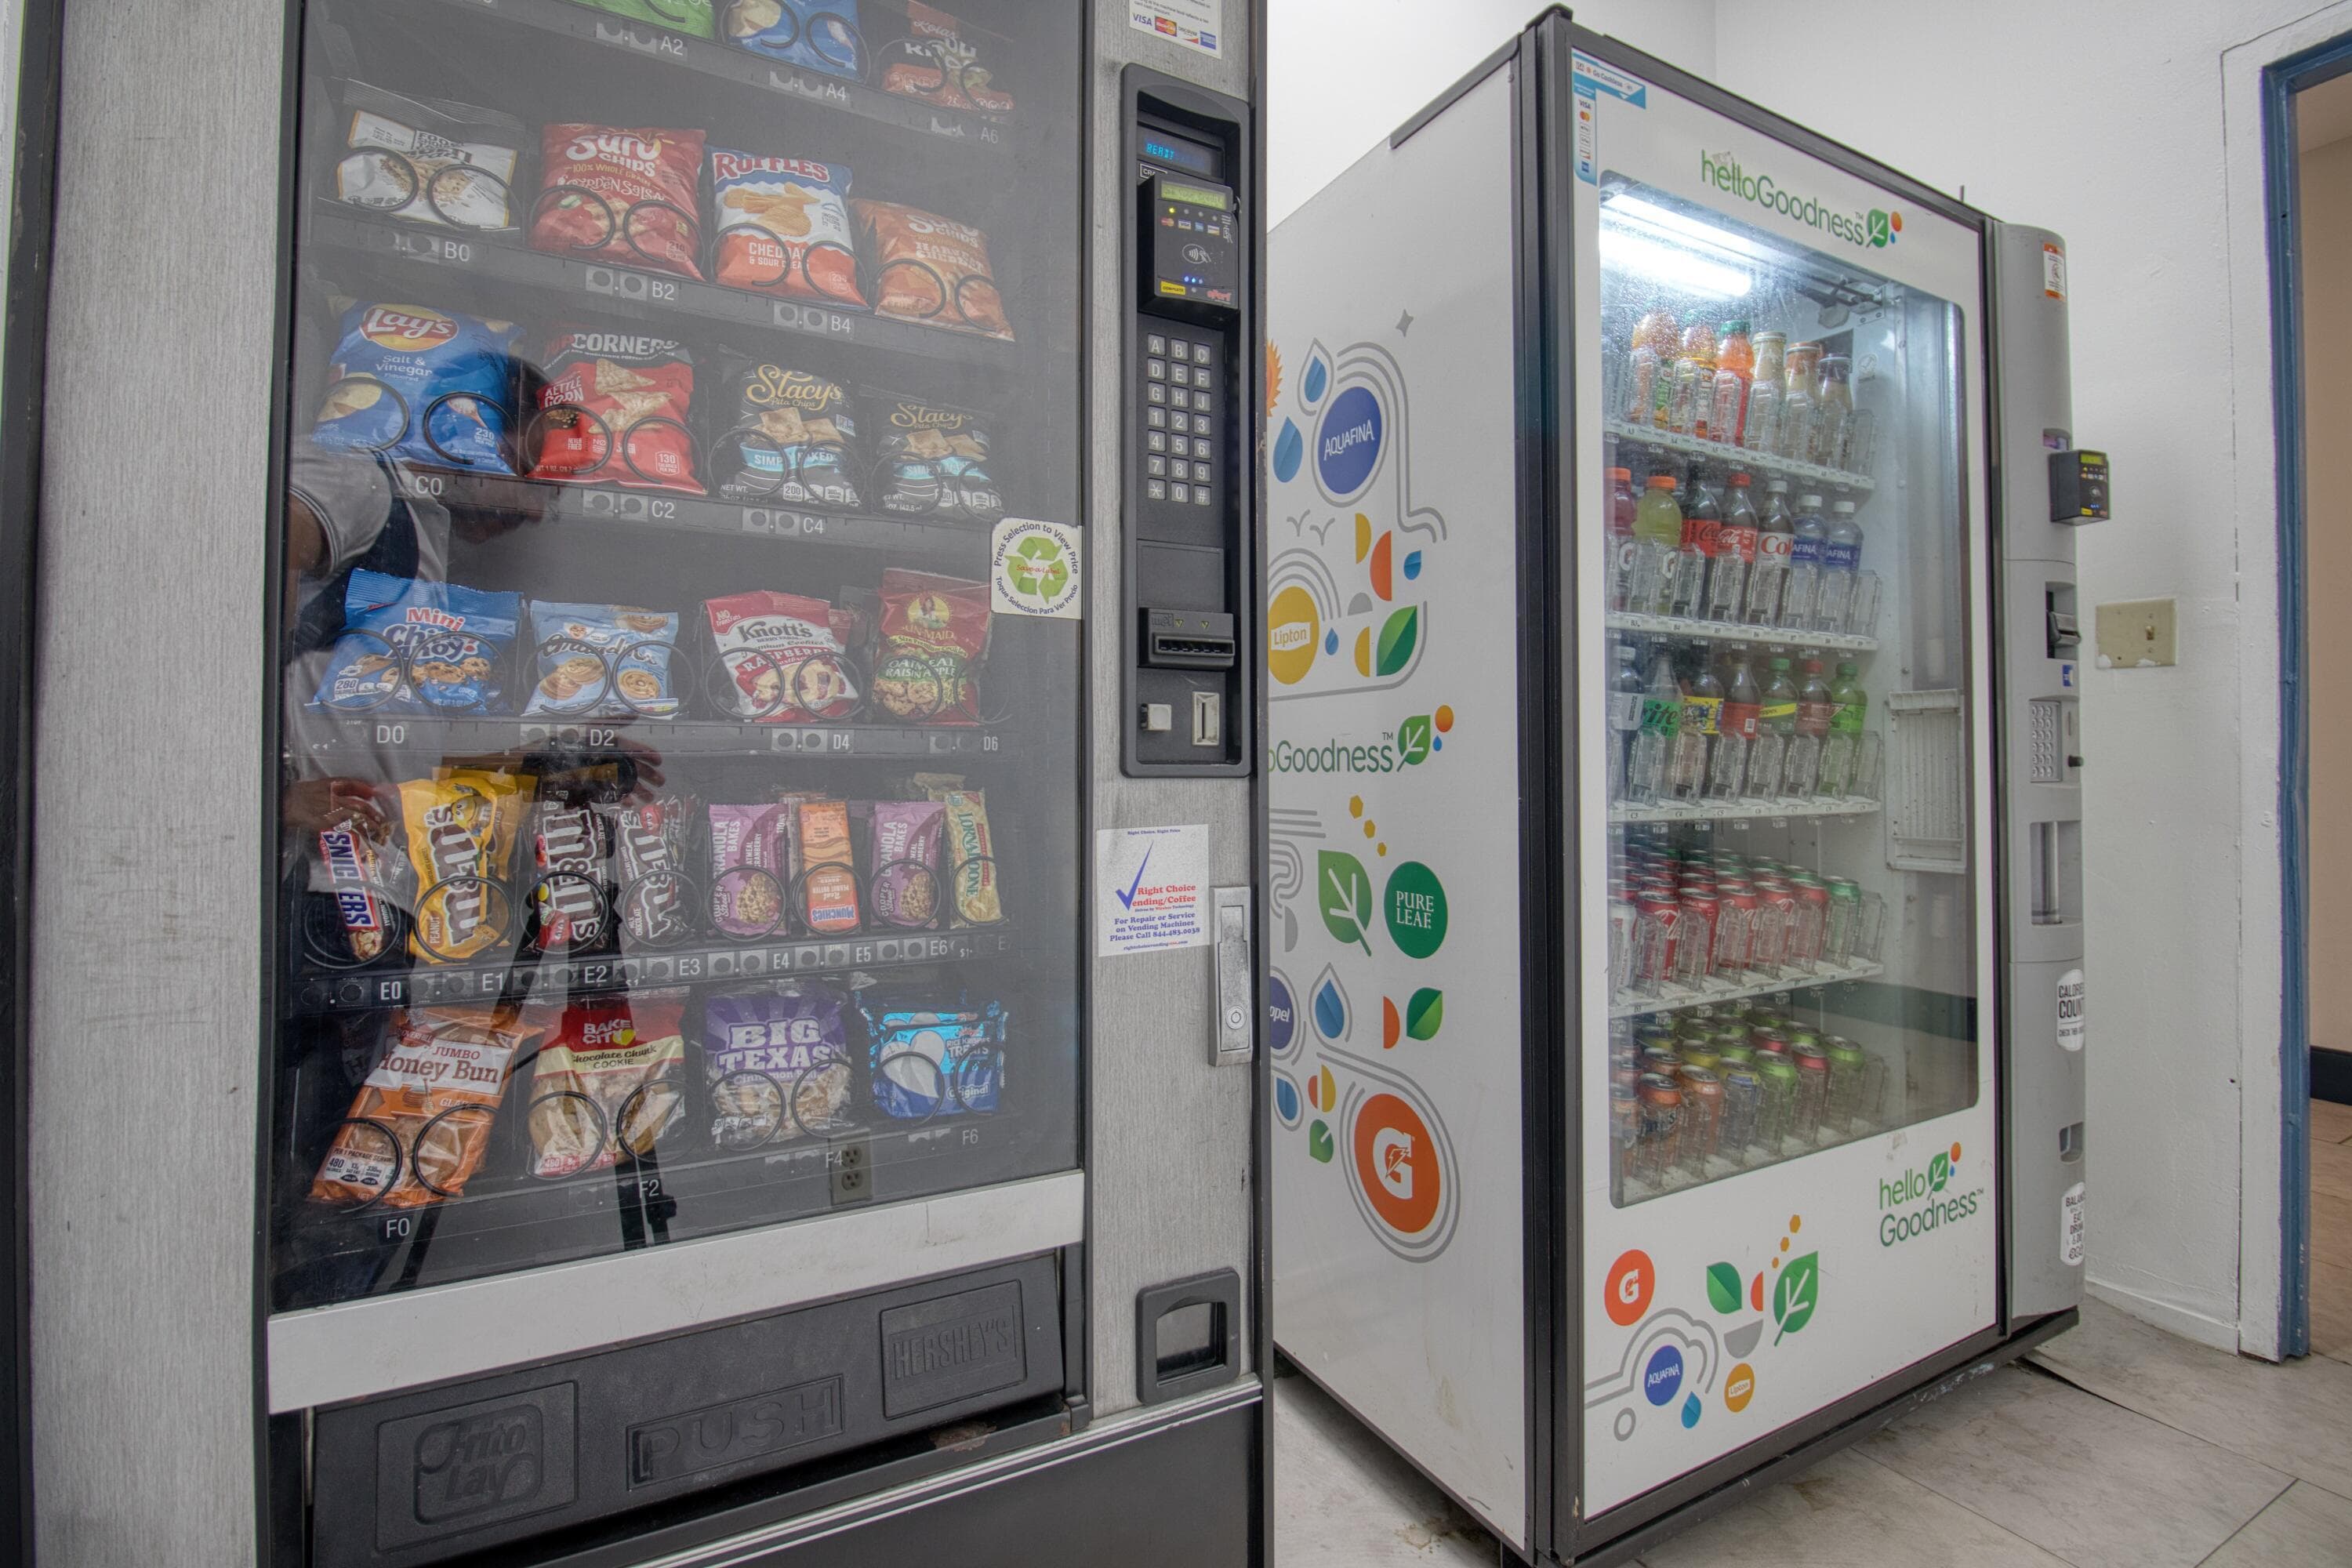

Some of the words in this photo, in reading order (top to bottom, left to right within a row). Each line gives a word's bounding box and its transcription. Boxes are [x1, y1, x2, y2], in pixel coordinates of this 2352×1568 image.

[1133, 13, 1152, 27] VISA
[660, 36, 684, 56] A2
[826, 83, 847, 101] A4
[981, 126, 999, 144] A6
[714, 152, 830, 183] RUFFLES
[444, 241, 470, 263] B0
[652, 281, 675, 302] B2
[367, 308, 454, 339] Lay's
[831, 315, 851, 335] B4
[1151, 339, 1160, 353] A
[1175, 343, 1183, 358] B
[1197, 348, 1206, 362] C
[383, 354, 412, 365] Salt
[414, 357, 427, 367] &
[1152, 363, 1160, 377] D
[1175, 368, 1183, 382] E
[1198, 372, 1205, 386] F
[746, 364, 843, 411] Stacy's
[1152, 387, 1160, 401] G
[1175, 392, 1183, 406] H
[1198, 395, 1205, 409] J
[1152, 411, 1159, 424] 1
[1175, 415, 1183, 429] 2
[1198, 419, 1206, 432] 3
[475, 427, 495, 441] 230
[1152, 435, 1160, 448] 4
[1323, 419, 1375, 461] AQUAFINA
[1175, 438, 1183, 452] 5
[1198, 441, 1206, 456] 6
[658, 453, 675, 464] 130
[1152, 459, 1160, 473] 7
[1175, 463, 1183, 477] 8
[1198, 466, 1206, 479] 9
[415, 476, 443, 495] C0
[1175, 486, 1183, 500] 0
[1197, 489, 1207, 504] #
[652, 500, 676, 519] C2
[803, 517, 824, 535] C4
[994, 543, 1007, 567] Press
[1004, 522, 1041, 543] Selection
[1043, 524, 1052, 534] to
[1054, 529, 1072, 550] View
[1069, 551, 1079, 575] Price
[996, 576, 1009, 599] Toque
[1007, 596, 1038, 615] Seleccion
[1054, 601, 1065, 611] Ver
[1065, 584, 1078, 604] Precio
[406, 607, 466, 632] Mini
[736, 620, 813, 644] Knott's
[1273, 628, 1308, 647] Lipton
[886, 667, 922, 679] RAISIN
[376, 724, 405, 745] D0
[590, 728, 615, 746] D2
[833, 734, 851, 750] D4
[983, 736, 998, 751] D6
[727, 821, 742, 853] BAKES
[893, 822, 909, 854] BAKES
[958, 812, 979, 855] LORNA
[322, 831, 376, 928] SNICERS
[1137, 887, 1164, 896] Right
[1166, 884, 1196, 894] Choice
[1396, 890, 1435, 913] PURE
[811, 903, 855, 923] MUNCHIES
[1130, 915, 1156, 926] Repair
[1167, 912, 1196, 920] Service
[429, 916, 441, 945] PEANUT
[1109, 934, 1134, 942] Please
[1152, 927, 1201, 938] 844.483.0038
[1127, 924, 1159, 933] Vending
[1160, 920, 1195, 929] Machines
[856, 946, 871, 964] E5
[930, 940, 948, 956] E6
[679, 958, 701, 976] E3
[773, 952, 790, 970] E4
[481, 972, 504, 993] E1
[584, 964, 608, 984] E2
[380, 981, 402, 1001] E0
[583, 1018, 631, 1035] BAKE
[729, 1019, 822, 1050] BIG
[583, 1029, 625, 1044] CITY
[432, 1047, 481, 1060] JUMBO
[624, 1044, 657, 1058] Chunk
[718, 1044, 833, 1075] TEXAS
[451, 1060, 499, 1083] Bun
[593, 1058, 635, 1069] COOKIE
[962, 1128, 979, 1145] F6
[328, 1156, 345, 1169] 480
[825, 1150, 844, 1169] F4
[1372, 1126, 1416, 1200] G
[639, 1178, 659, 1198] F2
[1879, 1167, 1926, 1210] hello
[386, 1217, 410, 1239] F0
[1618, 1269, 1639, 1304] G
[894, 1319, 1013, 1381] HERSHEY'S
[633, 1385, 837, 1485] PUSH
